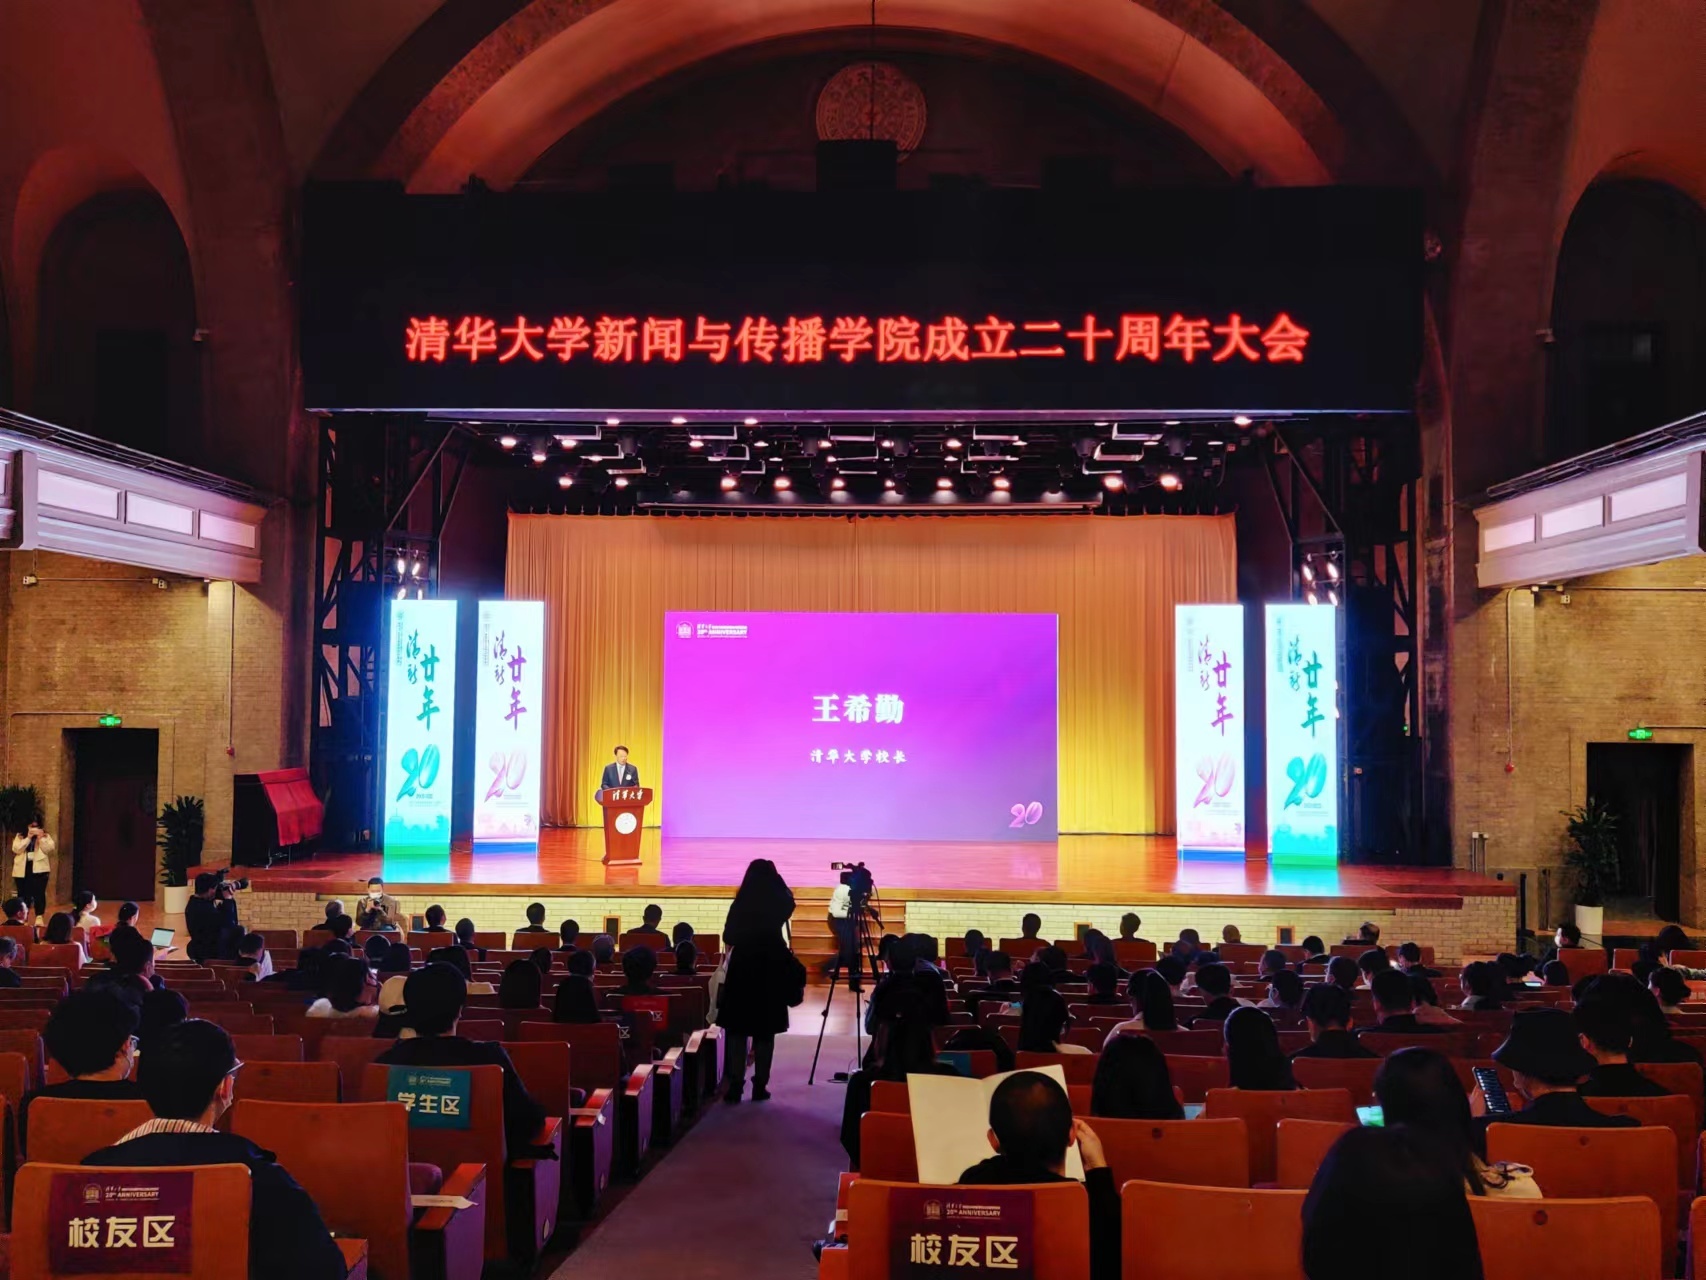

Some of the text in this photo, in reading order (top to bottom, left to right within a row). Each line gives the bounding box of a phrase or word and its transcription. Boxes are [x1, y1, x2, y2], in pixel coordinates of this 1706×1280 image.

[405, 312, 1310, 363] 清华大学新闻与传播学院成立二十周年大会
[811, 693, 905, 724] 王希勤
[397, 743, 441, 802] 20
[809, 747, 908, 766] 清华大学校长
[1283, 752, 1328, 810] 20
[1008, 801, 1043, 828] 20
[69, 1215, 175, 1247] 校友区
[910, 1233, 1019, 1269] 校友区
